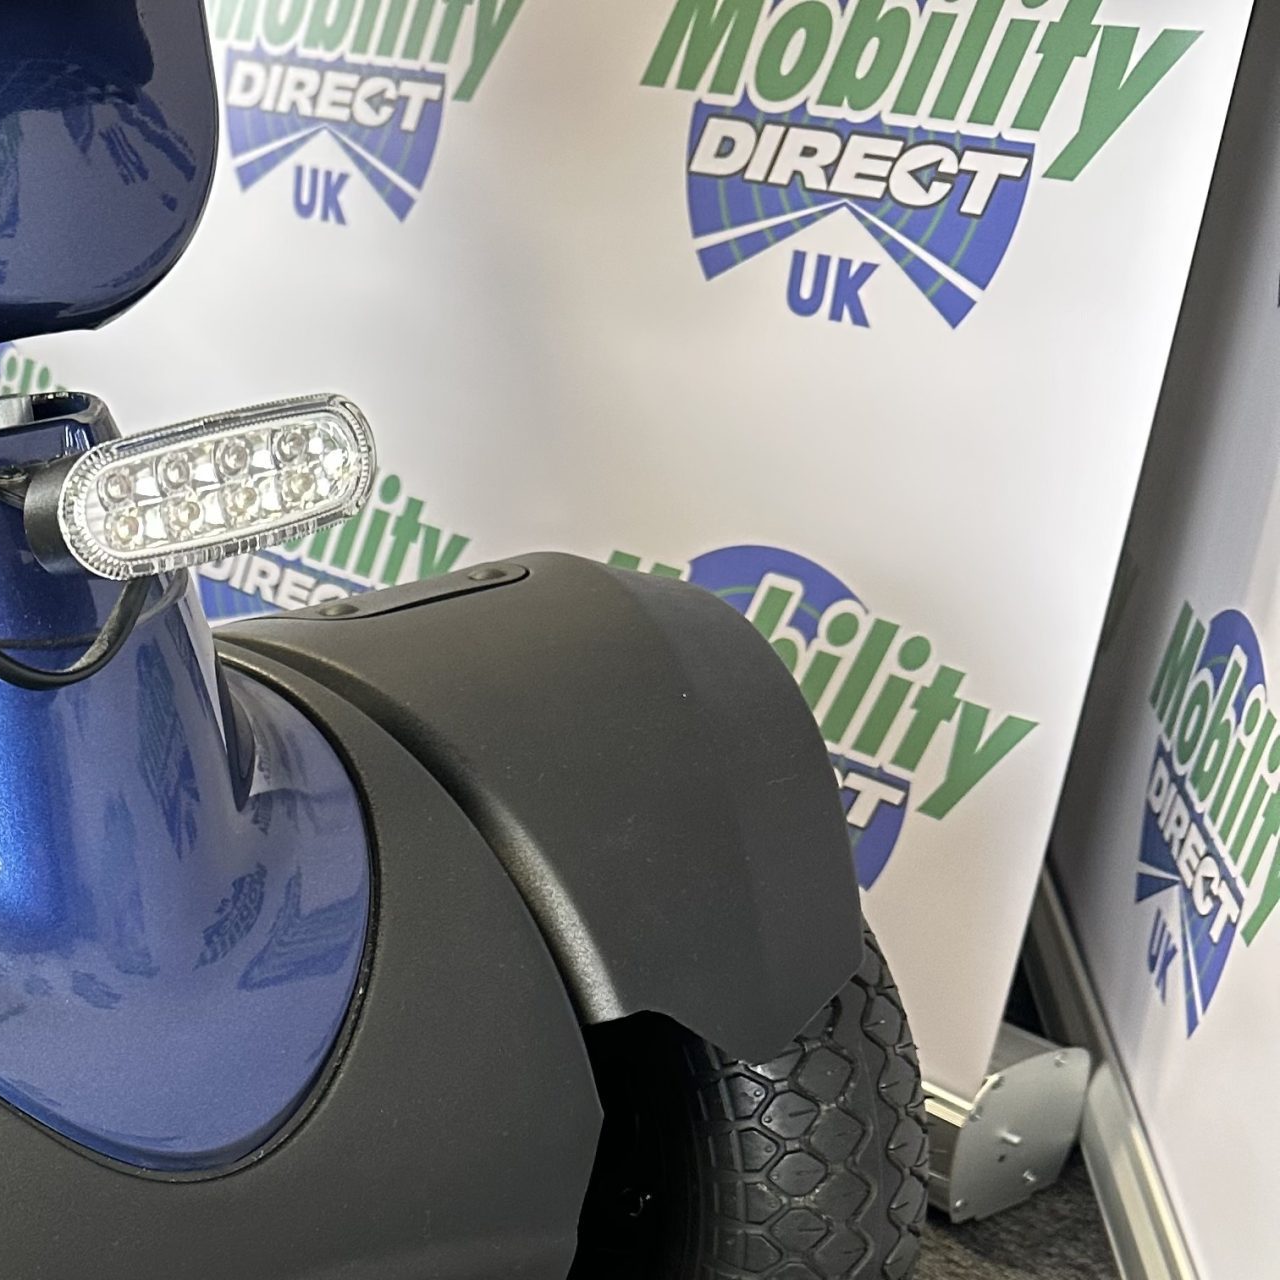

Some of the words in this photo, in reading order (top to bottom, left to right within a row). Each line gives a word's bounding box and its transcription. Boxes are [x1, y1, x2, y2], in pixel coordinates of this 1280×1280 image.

[226, 60, 442, 132] DIRECT
[640, 0, 1204, 182] Mobility
[292, 165, 350, 226] UK
[689, 116, 1030, 216] DIRECT
[786, 250, 880, 329] UK
[1148, 757, 1241, 943] DIRECT
[1148, 906, 1178, 1004] UK
